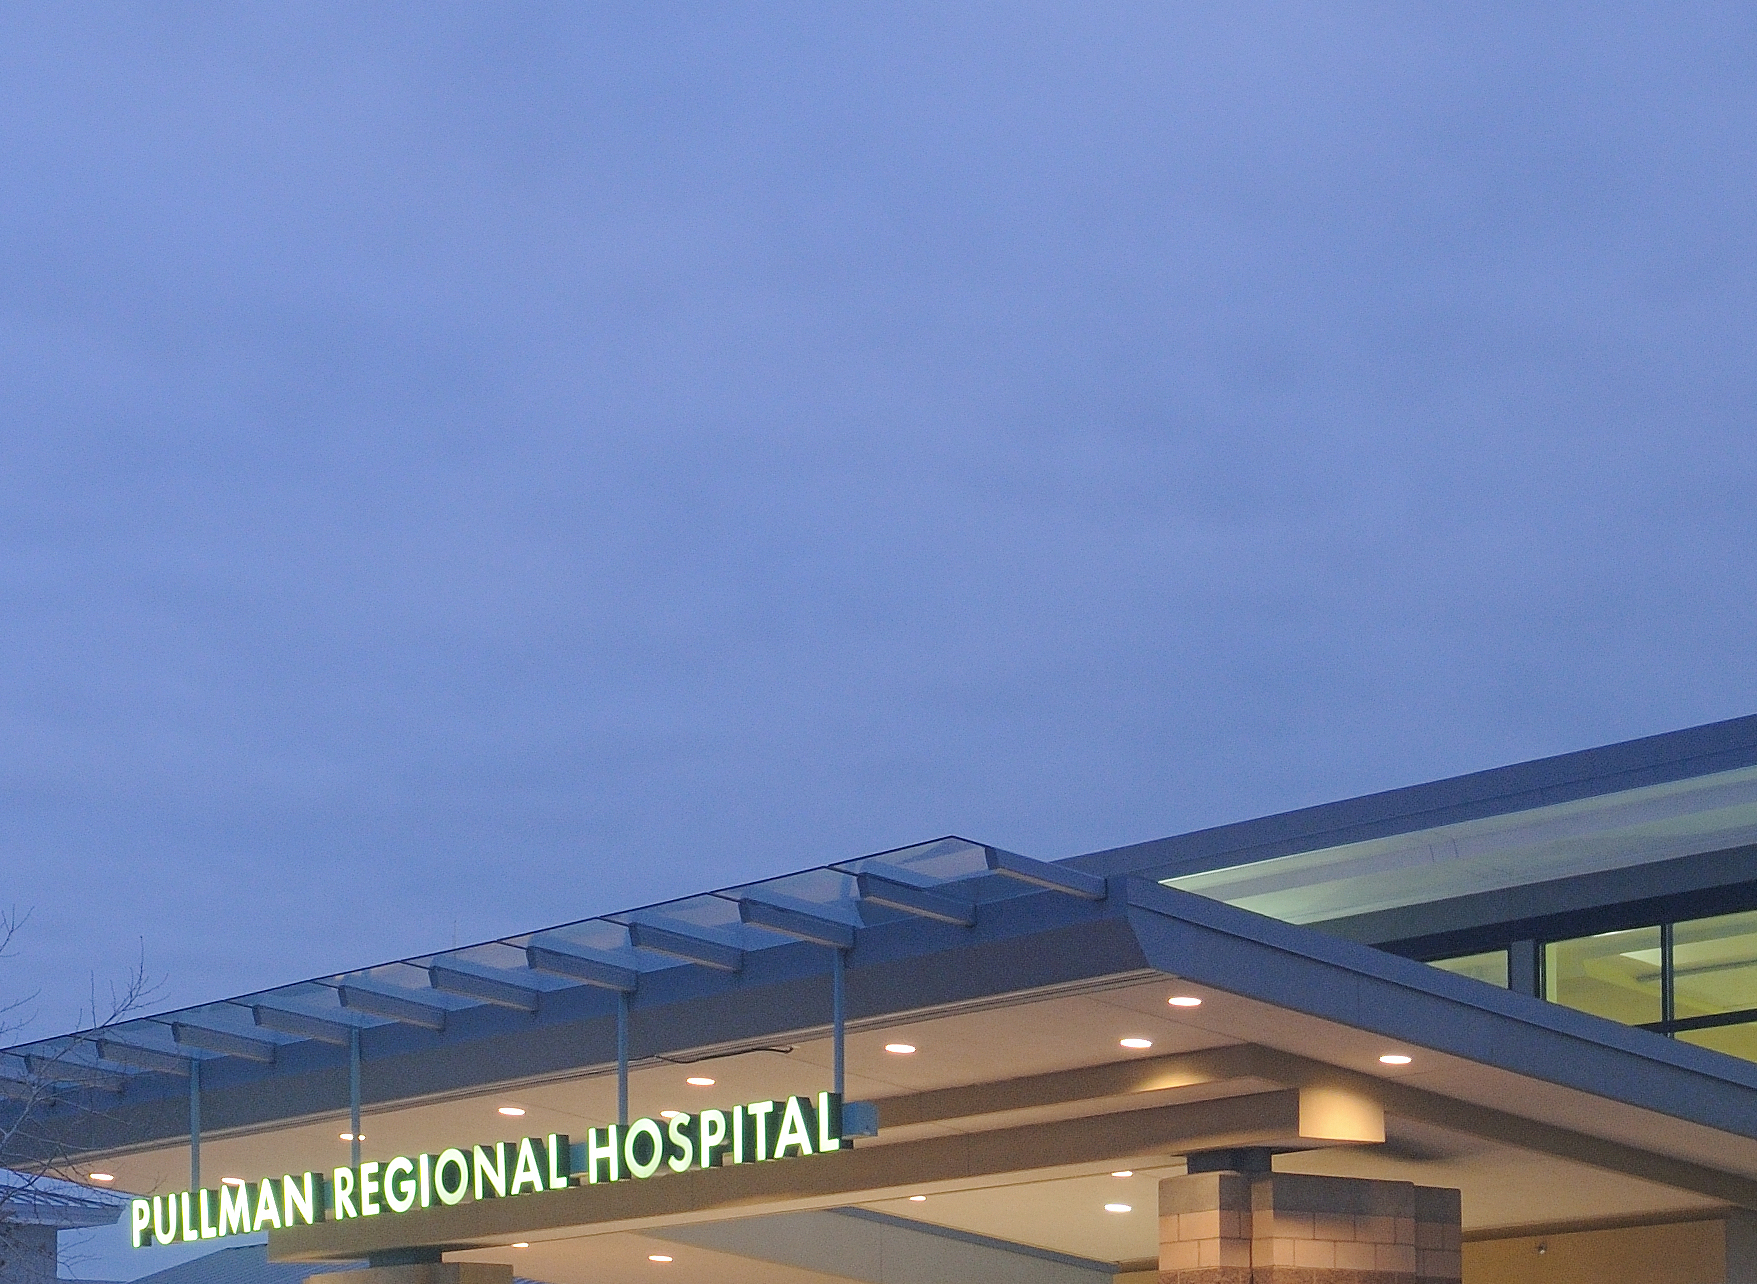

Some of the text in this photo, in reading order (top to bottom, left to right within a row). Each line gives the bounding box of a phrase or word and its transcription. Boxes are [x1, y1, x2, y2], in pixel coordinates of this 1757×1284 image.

[131, 1091, 841, 1248] PULLMAN REGIONAL HOSPITAL
